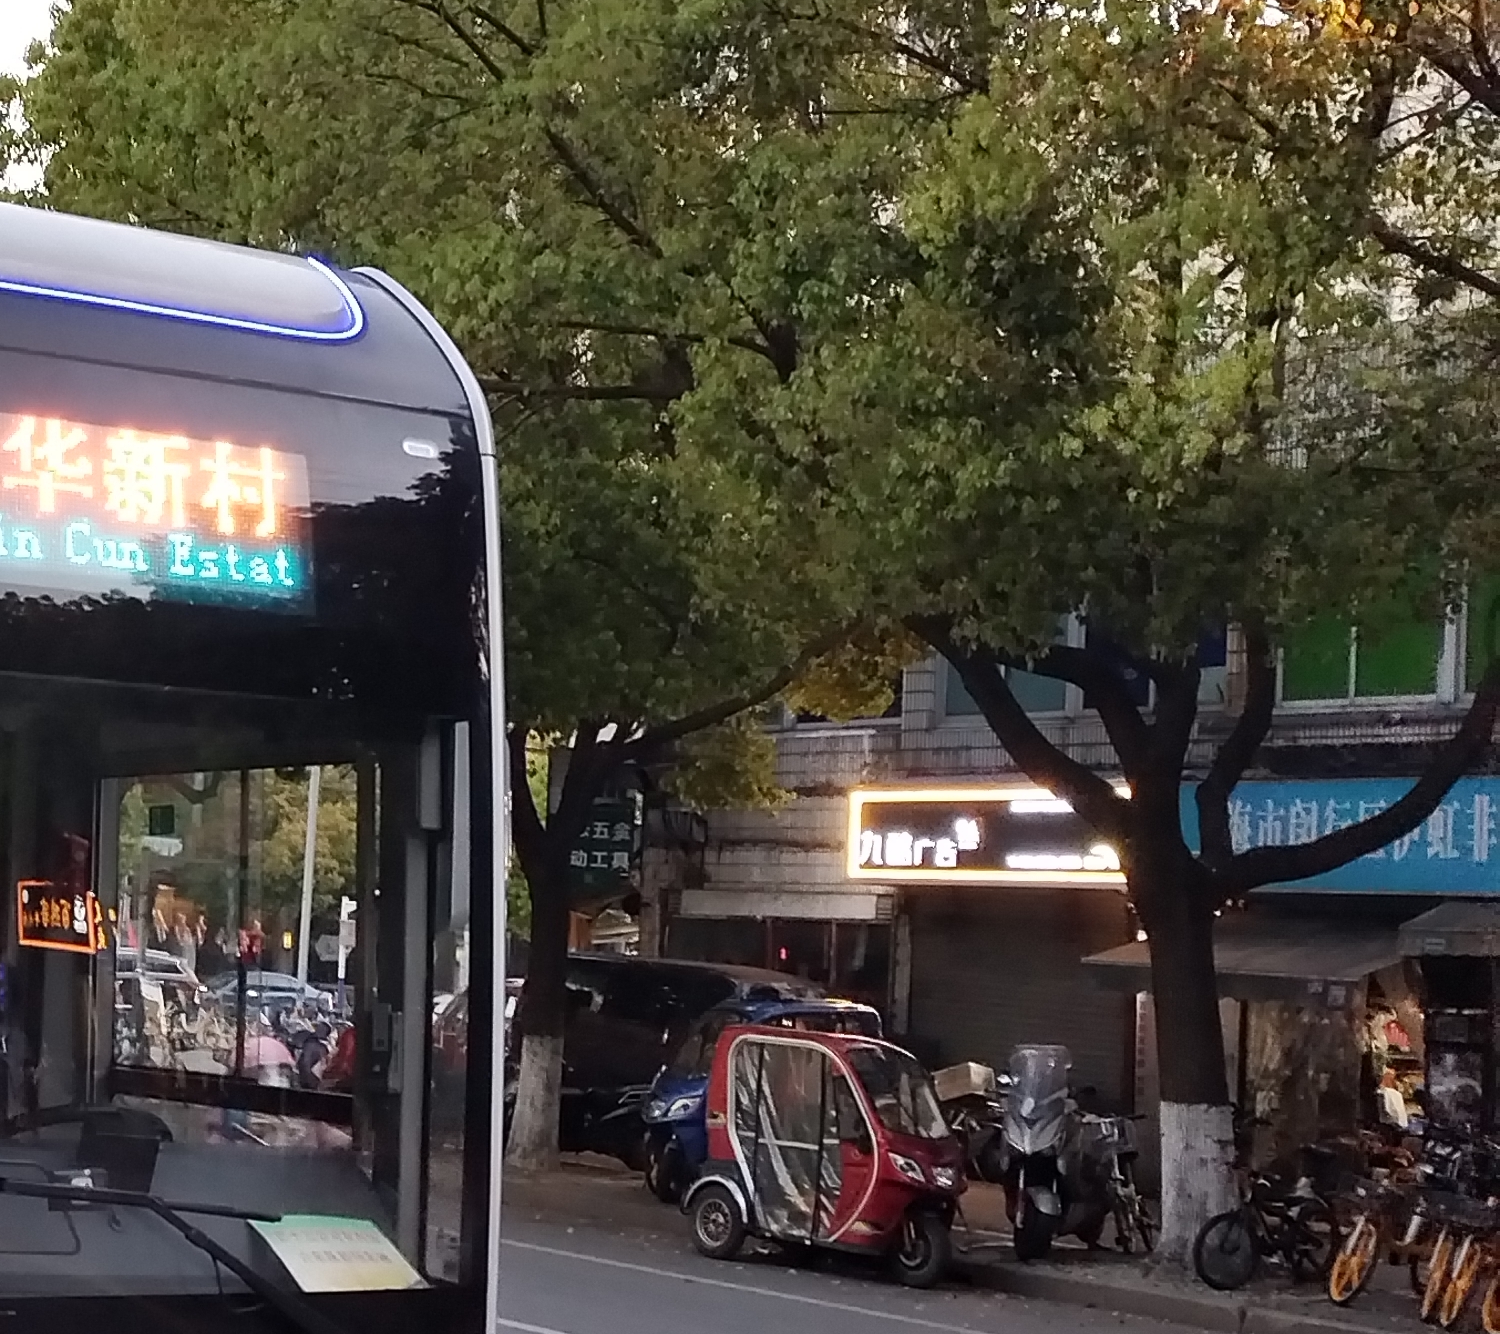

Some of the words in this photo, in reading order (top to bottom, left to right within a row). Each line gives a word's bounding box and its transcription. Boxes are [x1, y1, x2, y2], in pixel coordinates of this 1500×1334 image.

[64, 520, 150, 574] Cun
[168, 532, 297, 588] Estat
[580, 821, 631, 842] 五金
